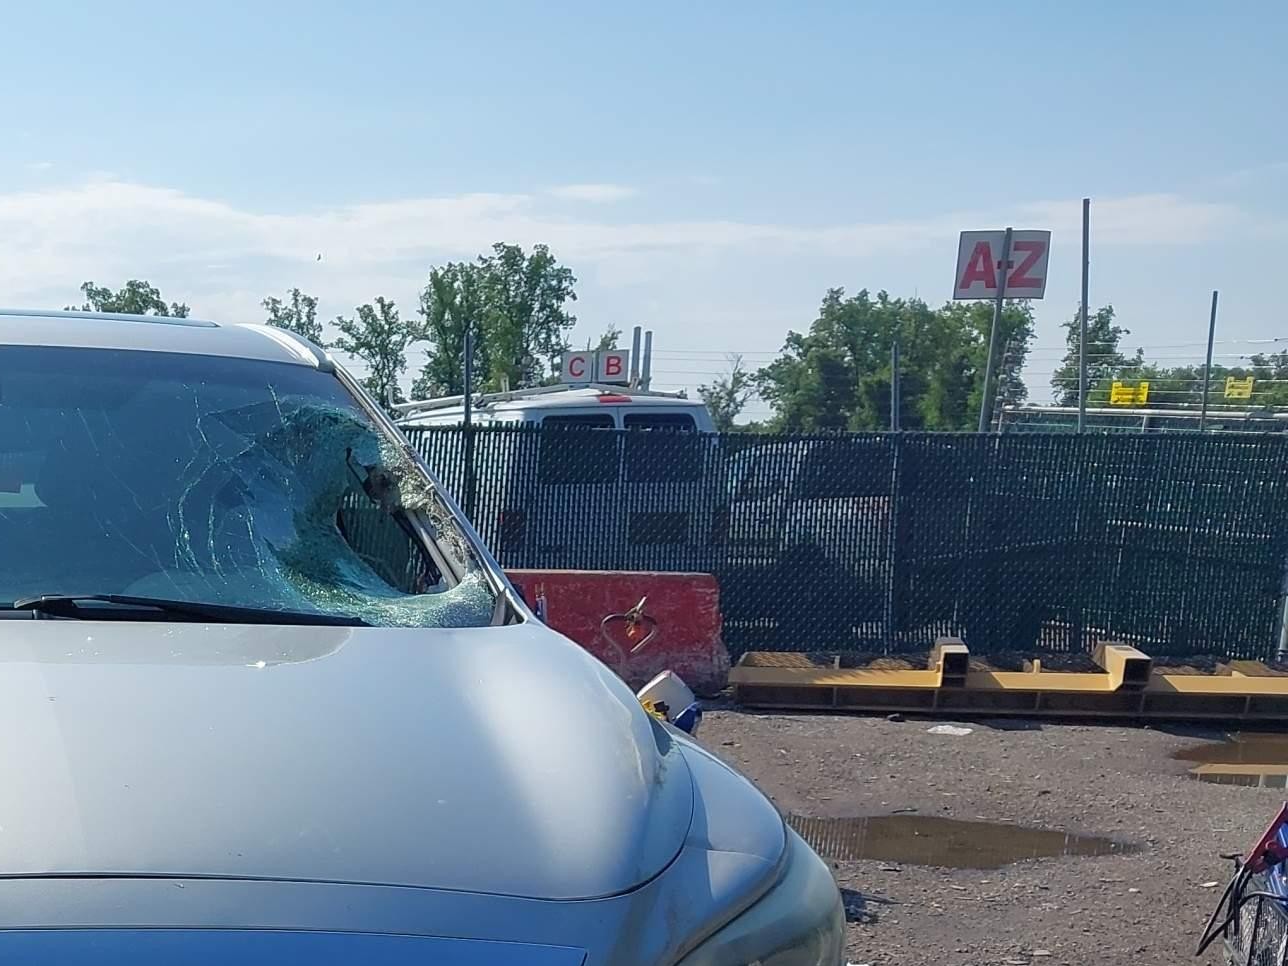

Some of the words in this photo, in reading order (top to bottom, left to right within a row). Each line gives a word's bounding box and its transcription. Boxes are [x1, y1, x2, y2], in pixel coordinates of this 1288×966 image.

[958, 240, 1047, 289] A-Z
[569, 356, 586, 377] C
[605, 355, 622, 376] B
